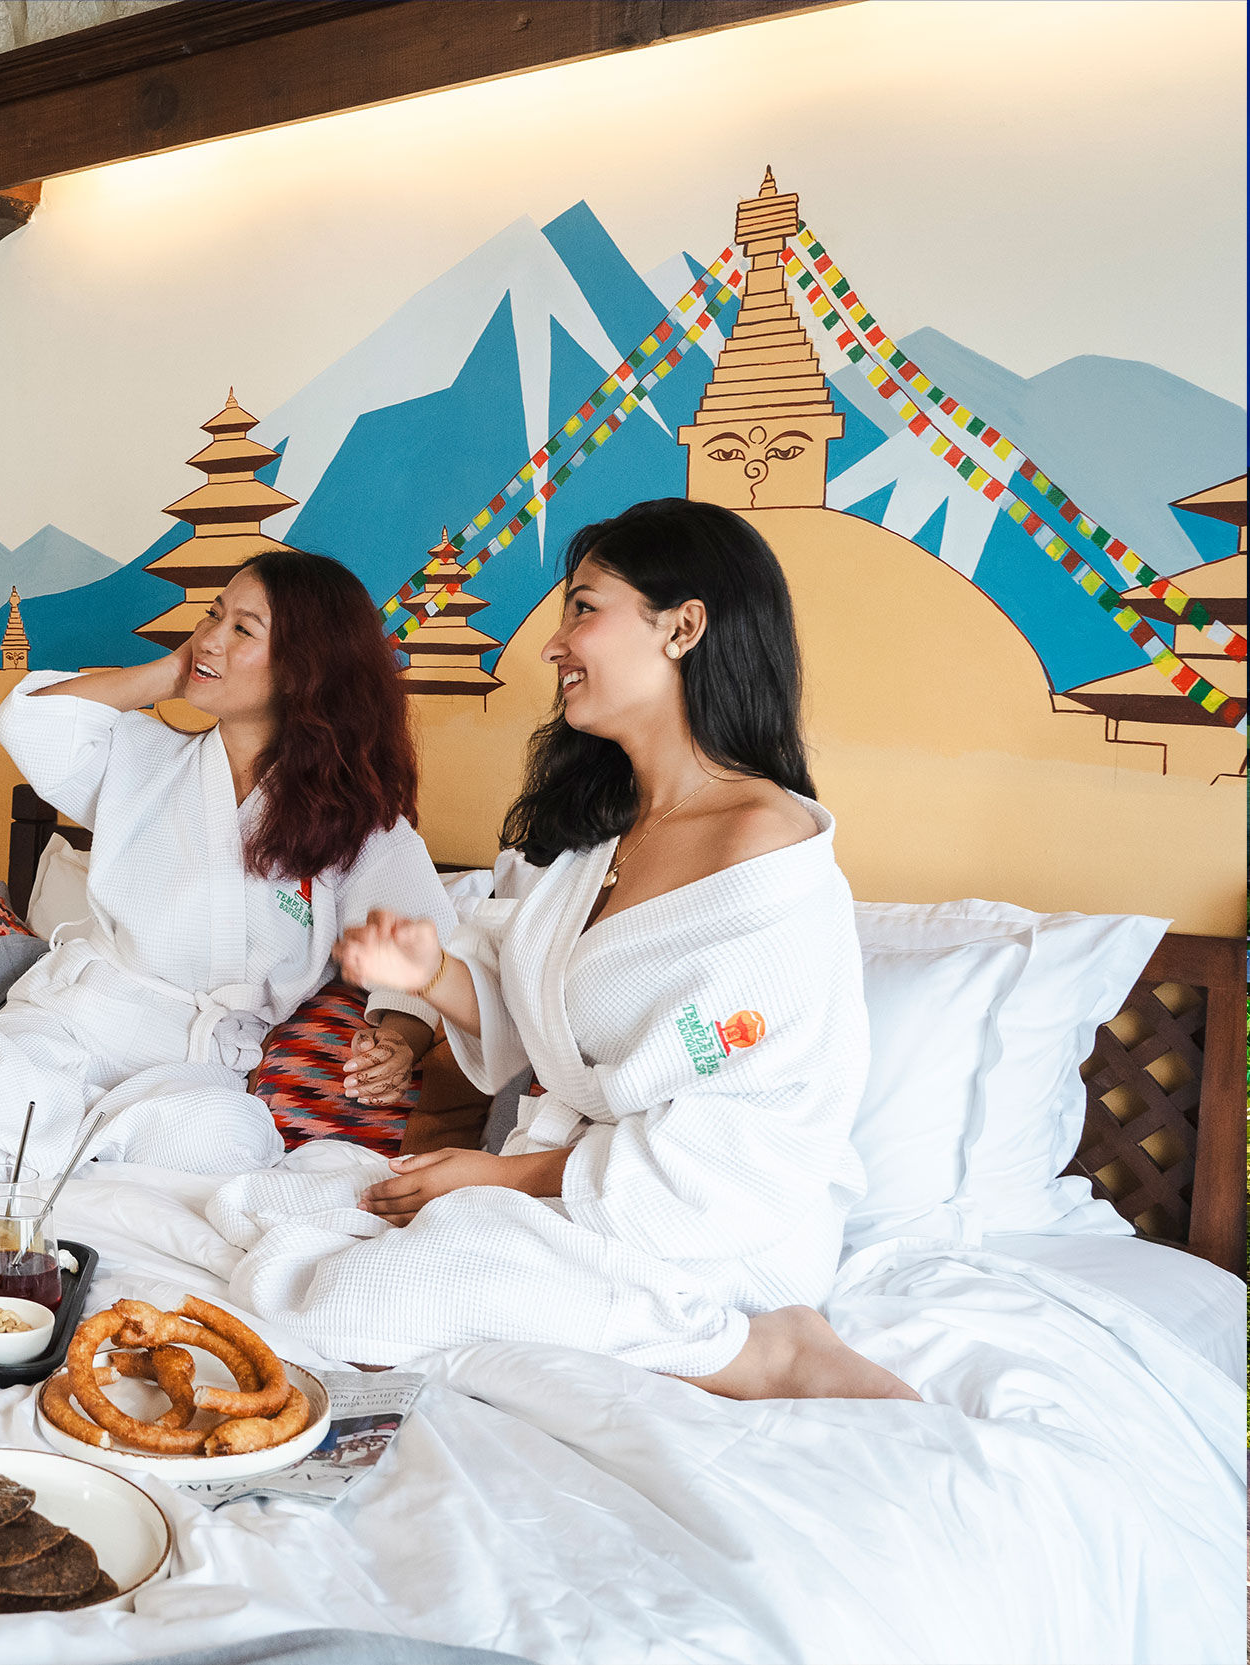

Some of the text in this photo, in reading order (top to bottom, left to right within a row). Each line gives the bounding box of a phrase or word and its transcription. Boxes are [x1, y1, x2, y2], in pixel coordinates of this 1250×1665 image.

[276, 889, 303, 914] TEMPLE
[675, 1018, 700, 1056] BOUTIQUE
[682, 1003, 713, 1053] TEMPLE
